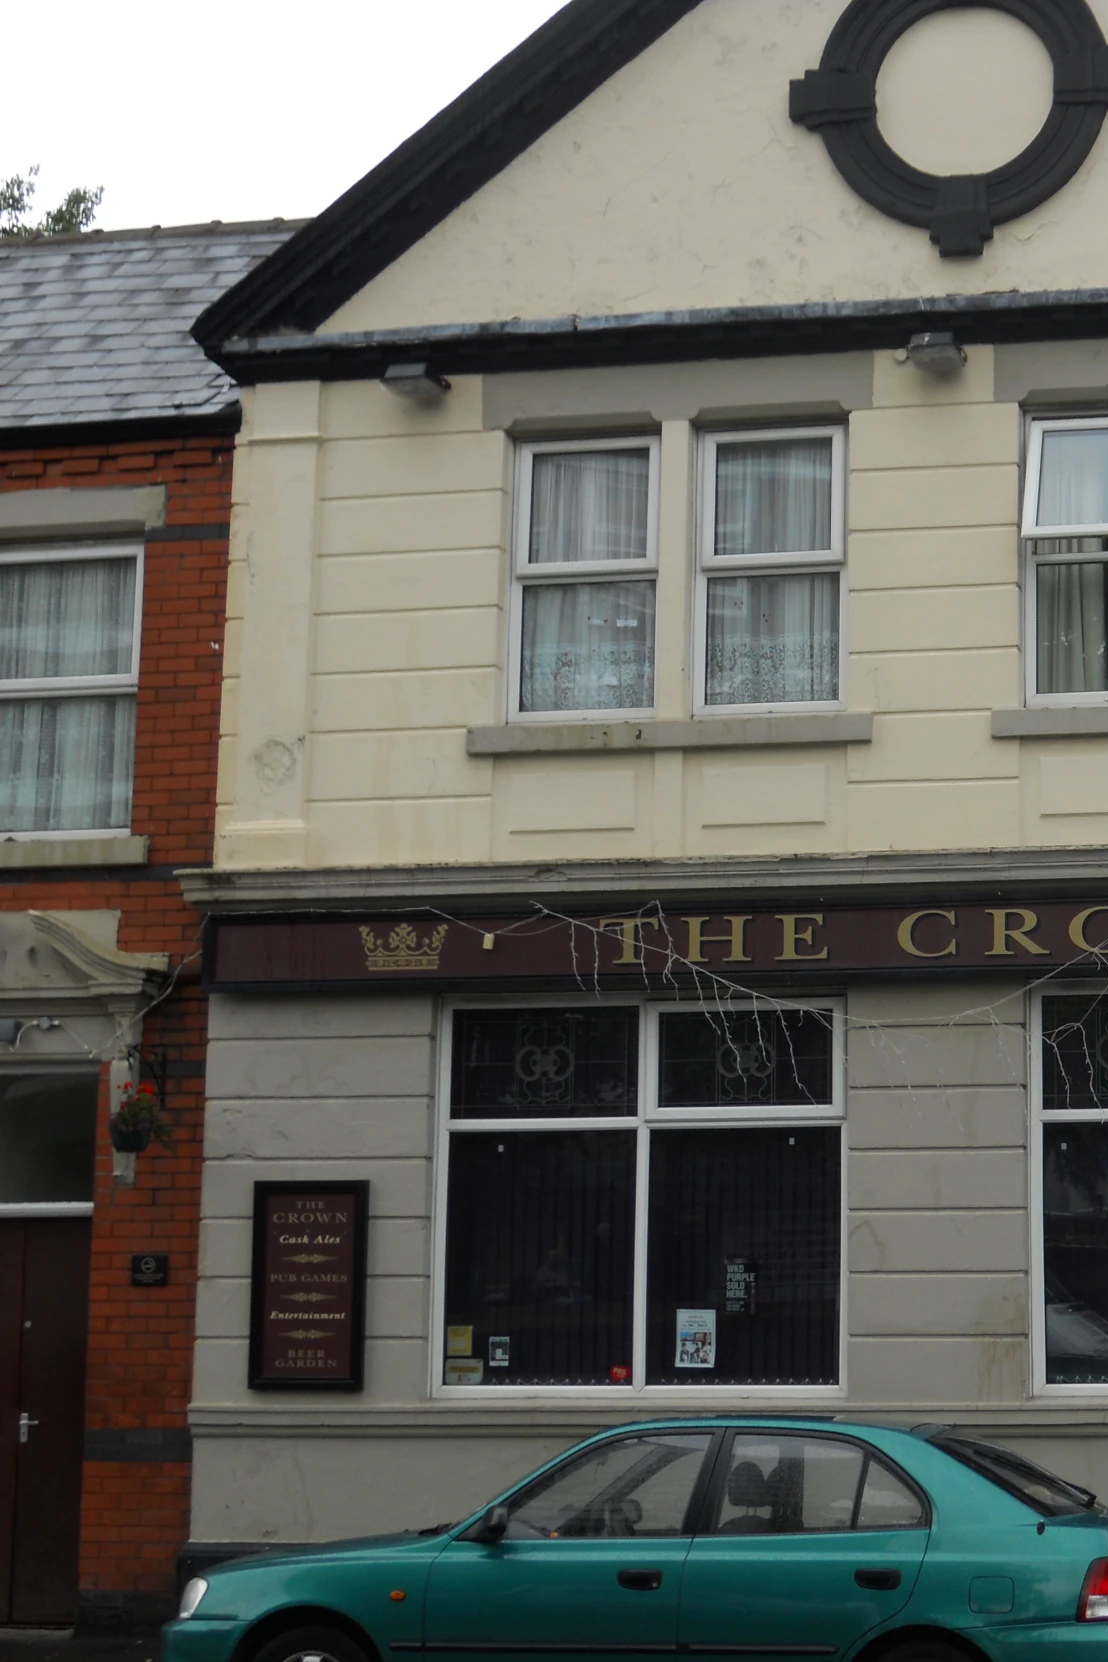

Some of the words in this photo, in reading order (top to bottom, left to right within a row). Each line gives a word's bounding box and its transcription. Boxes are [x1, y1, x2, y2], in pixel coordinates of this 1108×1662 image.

[599, 913, 830, 965] THE
[295, 1200, 326, 1209] THE
[273, 1212, 348, 1224] CROWN
[279, 1234, 309, 1245] Cask
[314, 1234, 341, 1244] Ales
[726, 1264, 745, 1273] WKD
[270, 1274, 297, 1283] PUB
[301, 1273, 348, 1283] GAMES
[726, 1272, 756, 1282] PURPLE
[726, 1281, 745, 1290] SOLD
[269, 1310, 346, 1320] Entertainment
[287, 1349, 326, 1358] BEER
[275, 1359, 337, 1368] GARDEN
